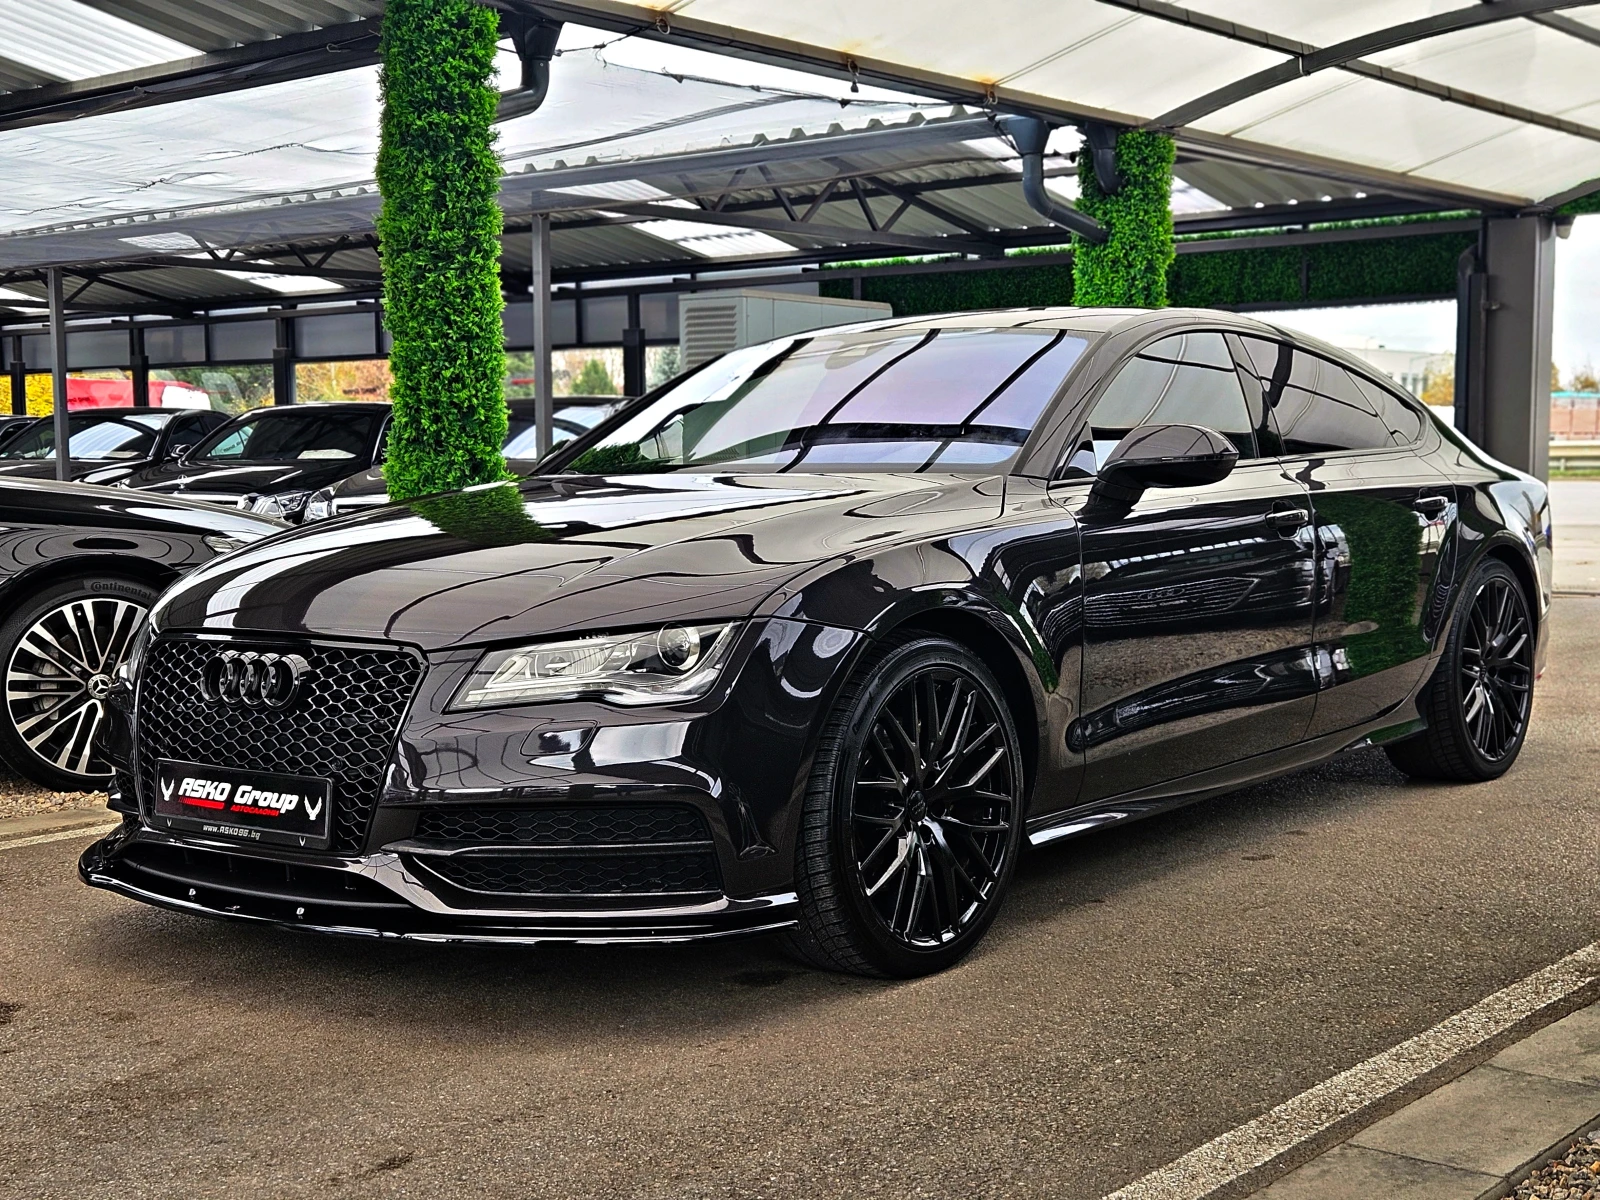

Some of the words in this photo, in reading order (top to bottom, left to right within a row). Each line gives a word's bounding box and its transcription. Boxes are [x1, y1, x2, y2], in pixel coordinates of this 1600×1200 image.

[90, 581, 152, 600] Continental
[178, 777, 231, 801] ASKO
[234, 784, 299, 814] Group
